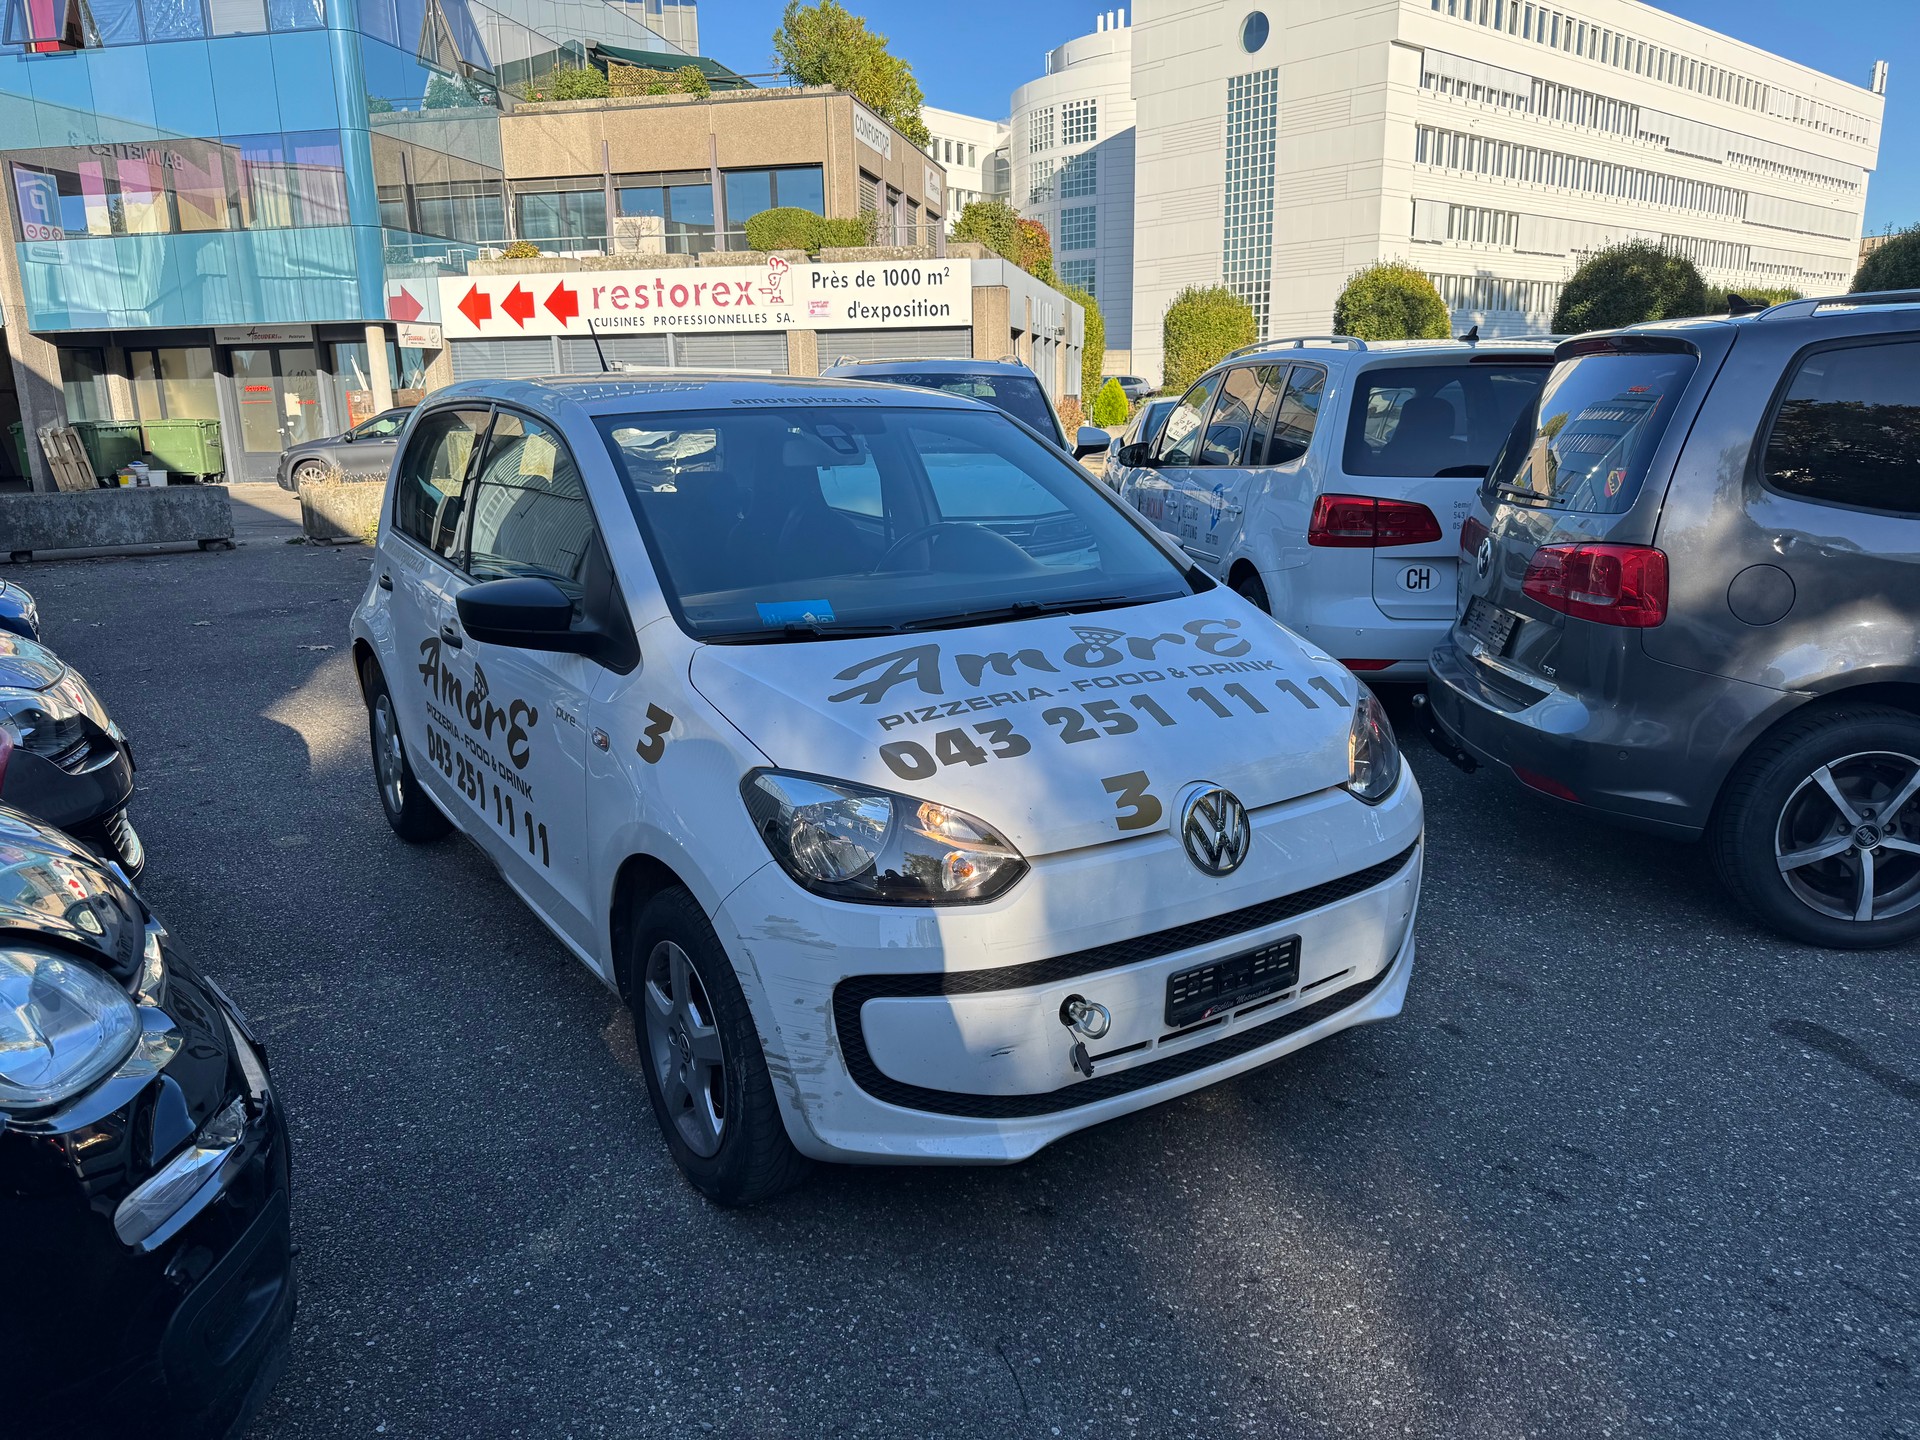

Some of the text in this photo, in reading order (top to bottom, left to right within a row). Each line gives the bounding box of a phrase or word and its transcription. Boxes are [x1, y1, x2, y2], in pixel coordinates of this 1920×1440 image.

[592, 277, 756, 310] restorex
[811, 270, 849, 289] Près
[855, 269, 876, 288] de
[882, 268, 921, 287] 1000
[594, 316, 646, 328] CUISINES
[653, 313, 768, 326] PROFESSIONNELLES
[776, 312, 796, 324] SA.
[847, 298, 950, 323] d'exposition
[730, 396, 882, 406] amorepizza.ch
[1406, 569, 1430, 590] CH
[877, 687, 1054, 731] PIZZERIA
[1070, 669, 1167, 693] FOOD
[1166, 667, 1189, 678] &
[1187, 660, 1285, 677] DRINK
[555, 706, 577, 728] pure
[636, 702, 675, 765] 3
[878, 675, 1352, 781] 043 251 11 11
[426, 700, 460, 743] PIZZERIA
[464, 733, 490, 768] FOOD
[497, 761, 534, 804] DRINK
[426, 723, 550, 868] 043 251 11 11
[1100, 770, 1164, 832] 3
